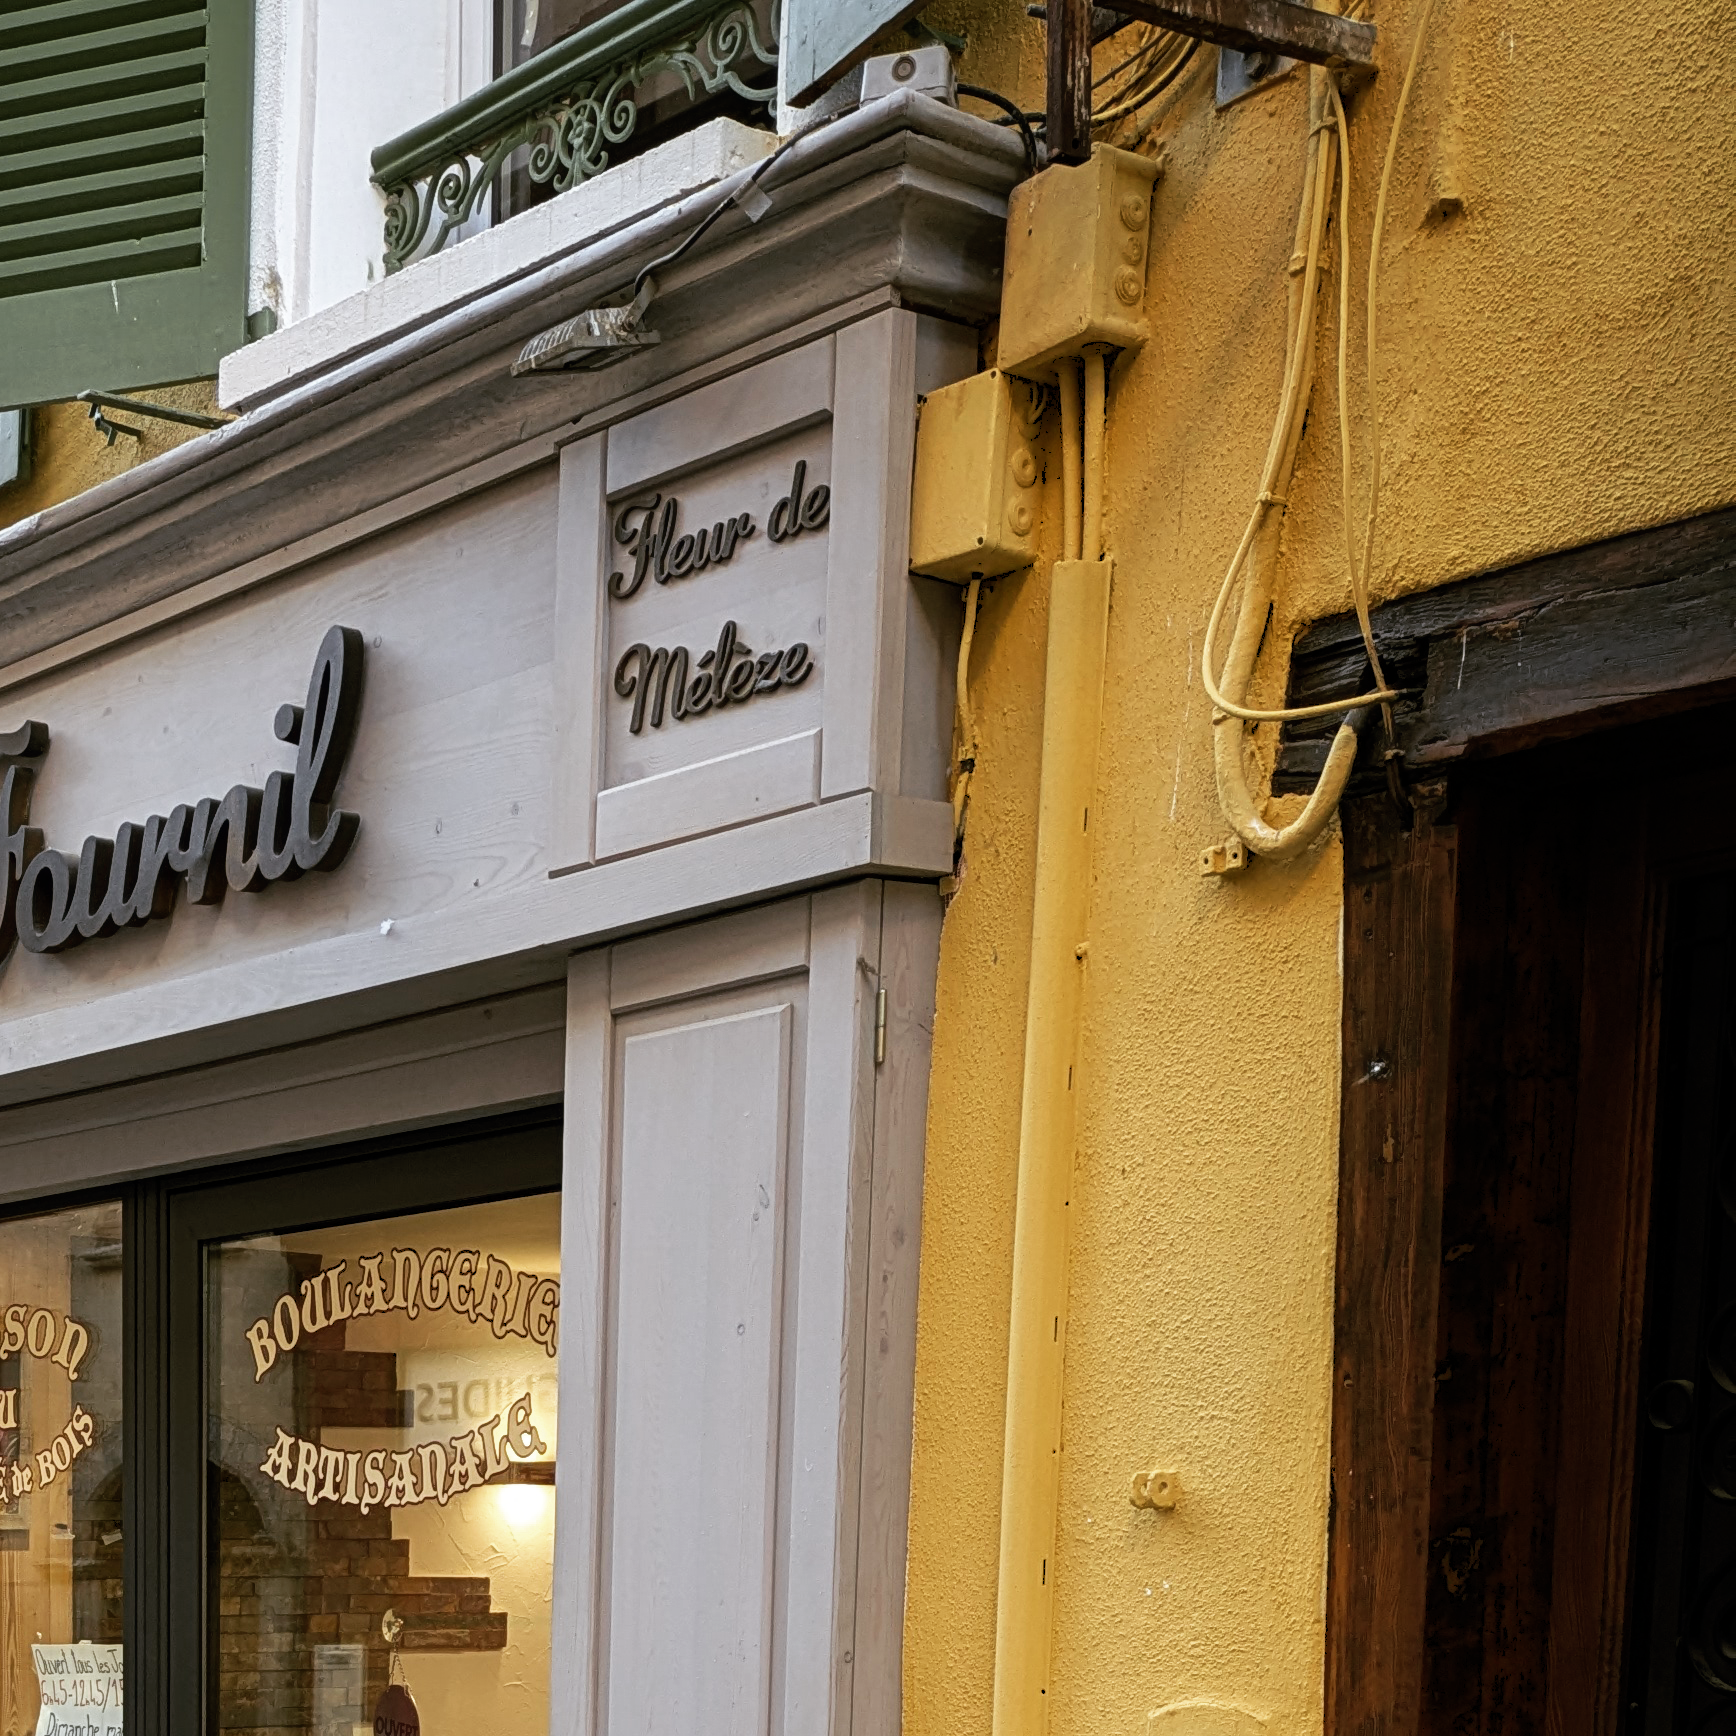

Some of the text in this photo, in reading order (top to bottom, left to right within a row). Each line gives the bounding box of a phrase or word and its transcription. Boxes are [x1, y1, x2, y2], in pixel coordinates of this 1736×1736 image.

[608, 459, 831, 599] Fleur de
[614, 619, 814, 735] Mélèze
[244, 1247, 560, 1383] BOULANGERIE
[12, 1461, 33, 1497] de
[35, 1403, 93, 1488] BOIS
[260, 1392, 547, 1515] ARTISANALE
